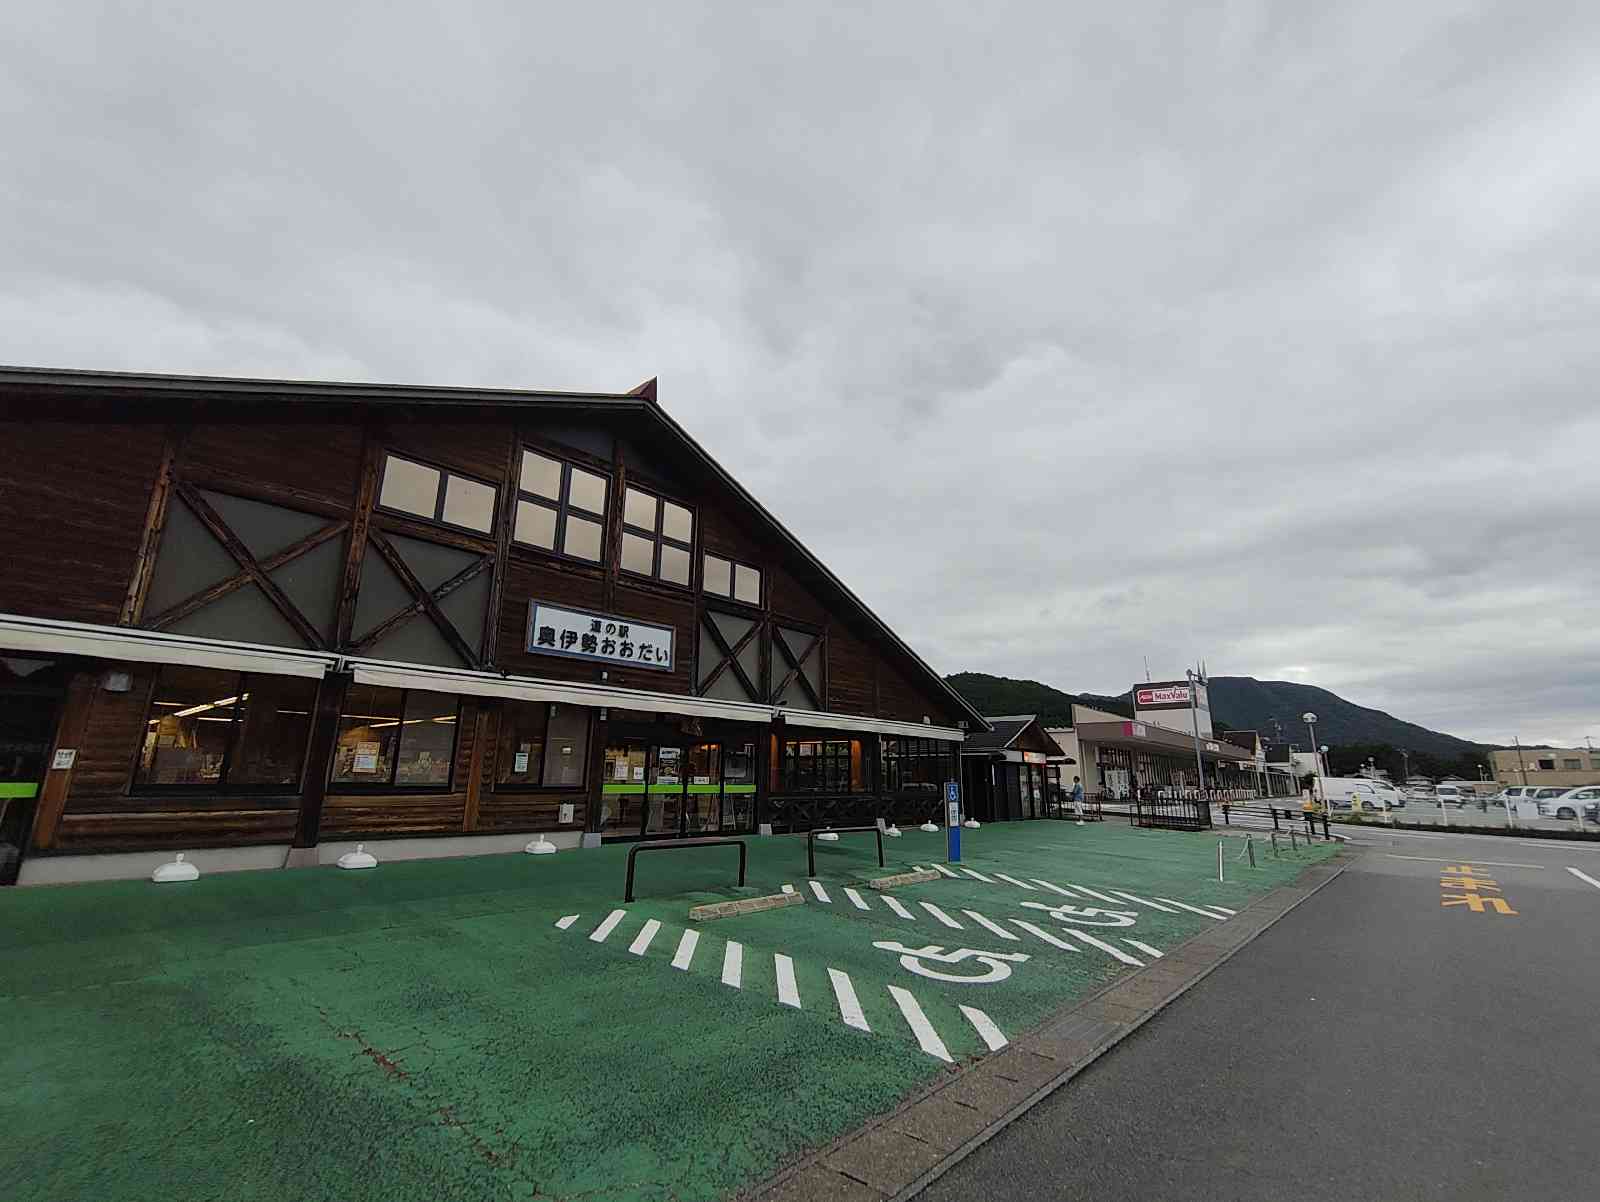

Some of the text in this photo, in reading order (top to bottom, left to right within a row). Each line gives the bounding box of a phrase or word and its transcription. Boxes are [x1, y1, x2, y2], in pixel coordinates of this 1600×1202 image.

[591, 619, 629, 639] 道の駅
[538, 626, 668, 662] 奥伊勢おおだい
[1155, 688, 1188, 700] MaxValu
[1440, 865, 1519, 914] 止まれ
